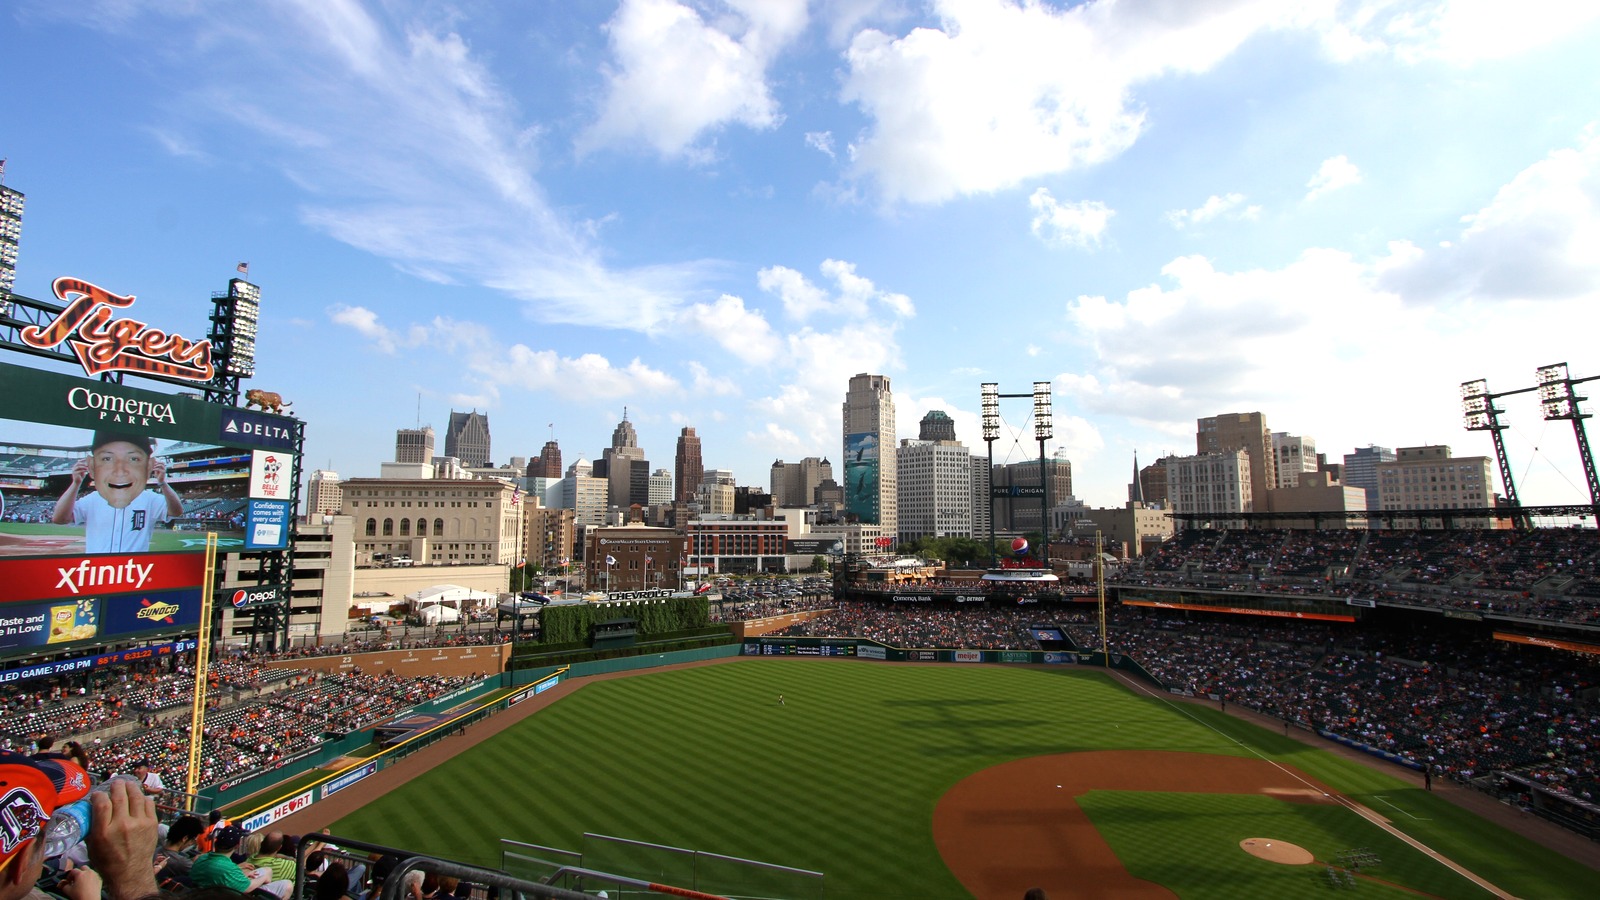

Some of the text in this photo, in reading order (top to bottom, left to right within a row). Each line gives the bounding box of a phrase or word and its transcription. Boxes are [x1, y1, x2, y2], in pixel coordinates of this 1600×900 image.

[20, 276, 214, 381] Tigers
[99, 411, 150, 427] PARK
[242, 421, 290, 440] DELTA
[261, 483, 279, 491] BELLE
[253, 502, 284, 510] Confidence
[55, 557, 154, 593] xfinity
[248, 588, 276, 604] pepsi
[609, 589, 675, 601] CHEVROLET
[596, 600, 666, 608] FOUNTAIN
[139, 605, 177, 617] SUNOCO
[25, 614, 45, 624] and
[7, 627, 18, 635] In
[18, 625, 43, 634] Love
[123, 650, 153, 661] 6:31:22
[158, 646, 171, 655] PM
[957, 652, 978, 660] meijer
[342, 656, 352, 664] 23
[0, 660, 91, 682] LED GAME: 7:08 PM
[282, 757, 295, 766] ATI
[228, 778, 243, 788] ATI
[244, 813, 271, 832] DMC
